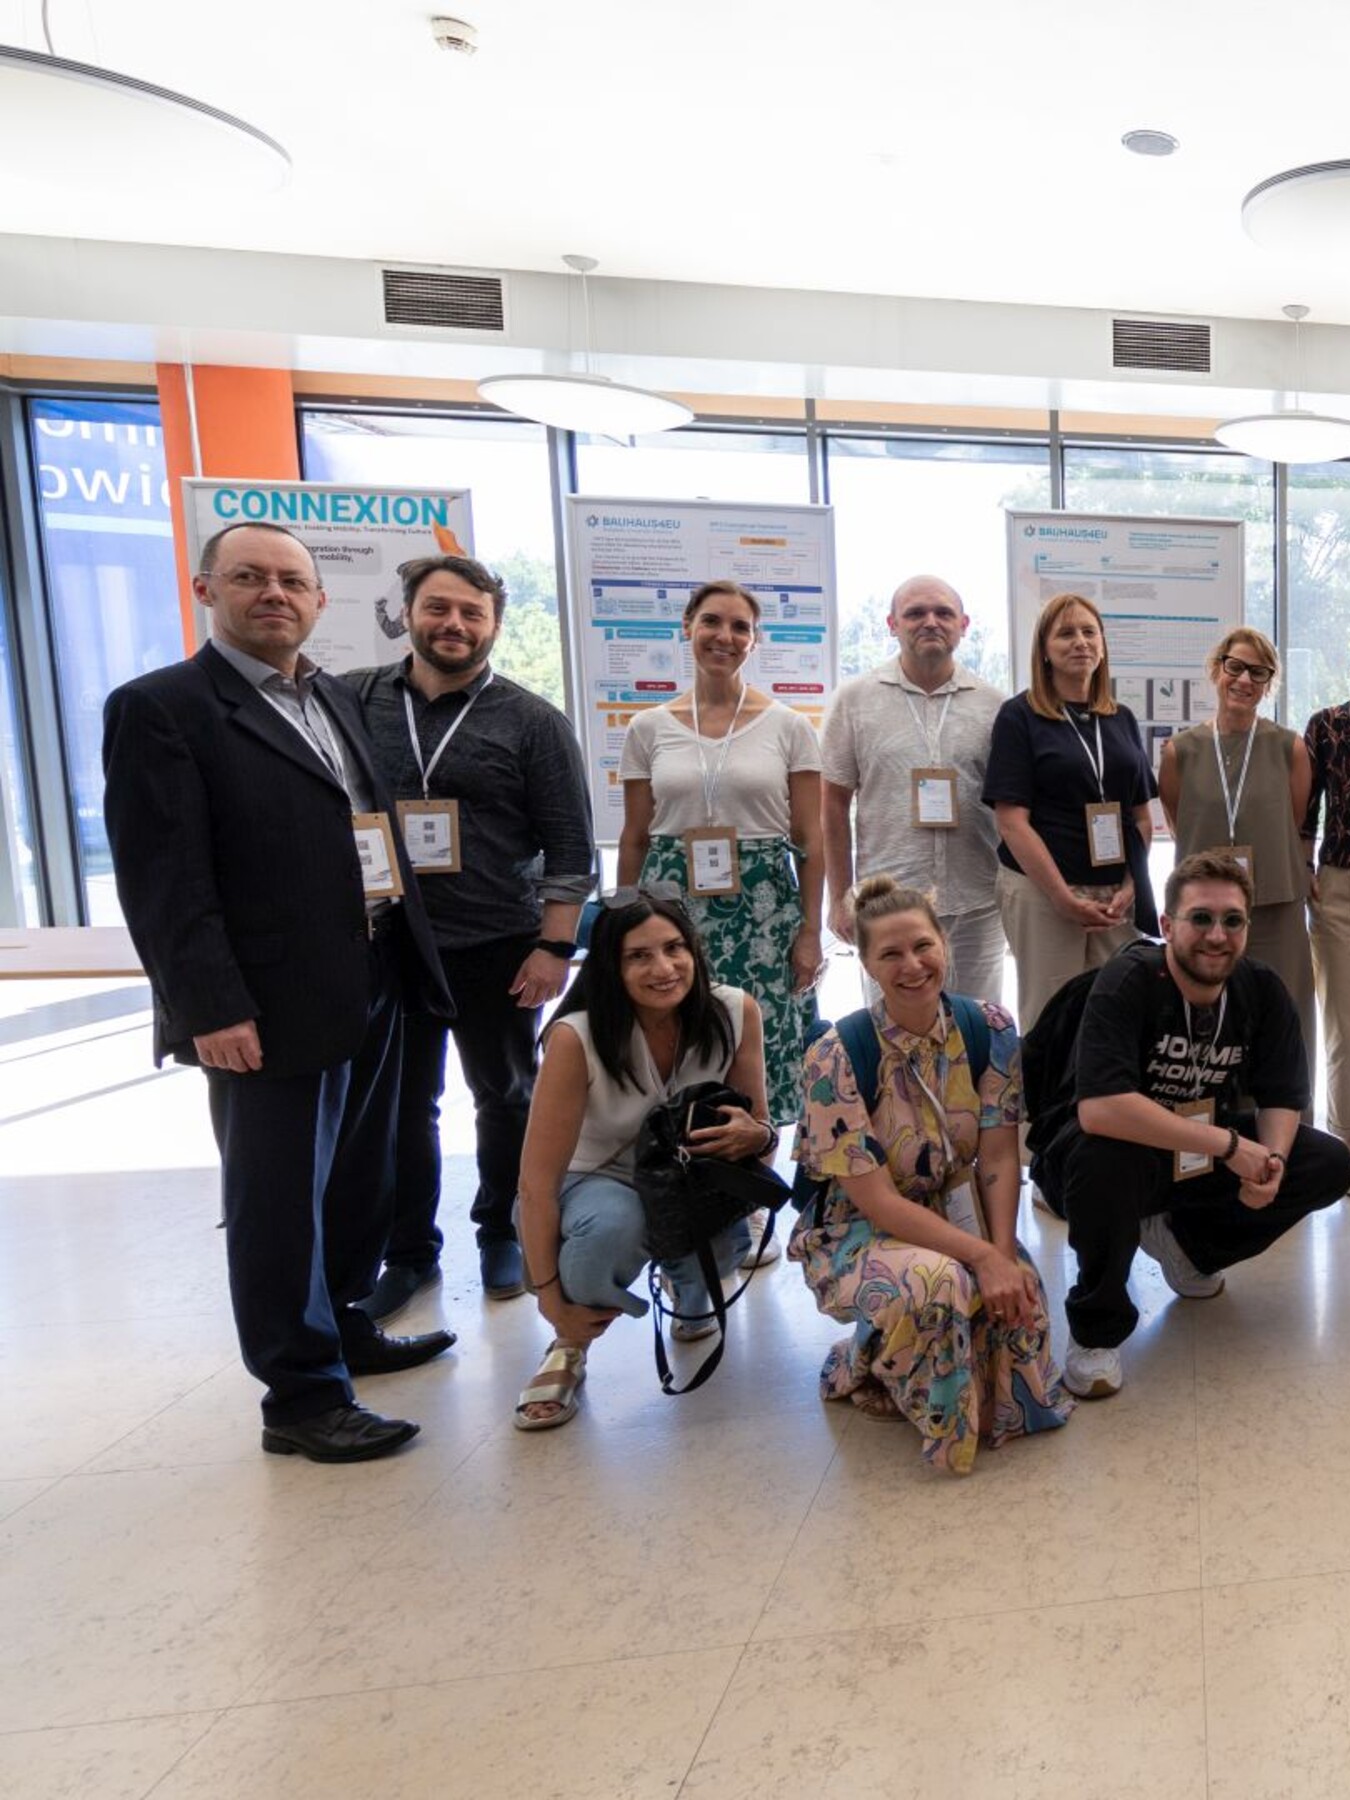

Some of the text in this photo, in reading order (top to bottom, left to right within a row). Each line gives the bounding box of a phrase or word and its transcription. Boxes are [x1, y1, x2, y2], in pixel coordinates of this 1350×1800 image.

[39, 463, 171, 507] owi
[213, 489, 449, 526] CONNEXION
[603, 516, 680, 529] BAUHAUS4EU
[1038, 526, 1108, 540] BAUHAUS4EU
[342, 545, 374, 554] through
